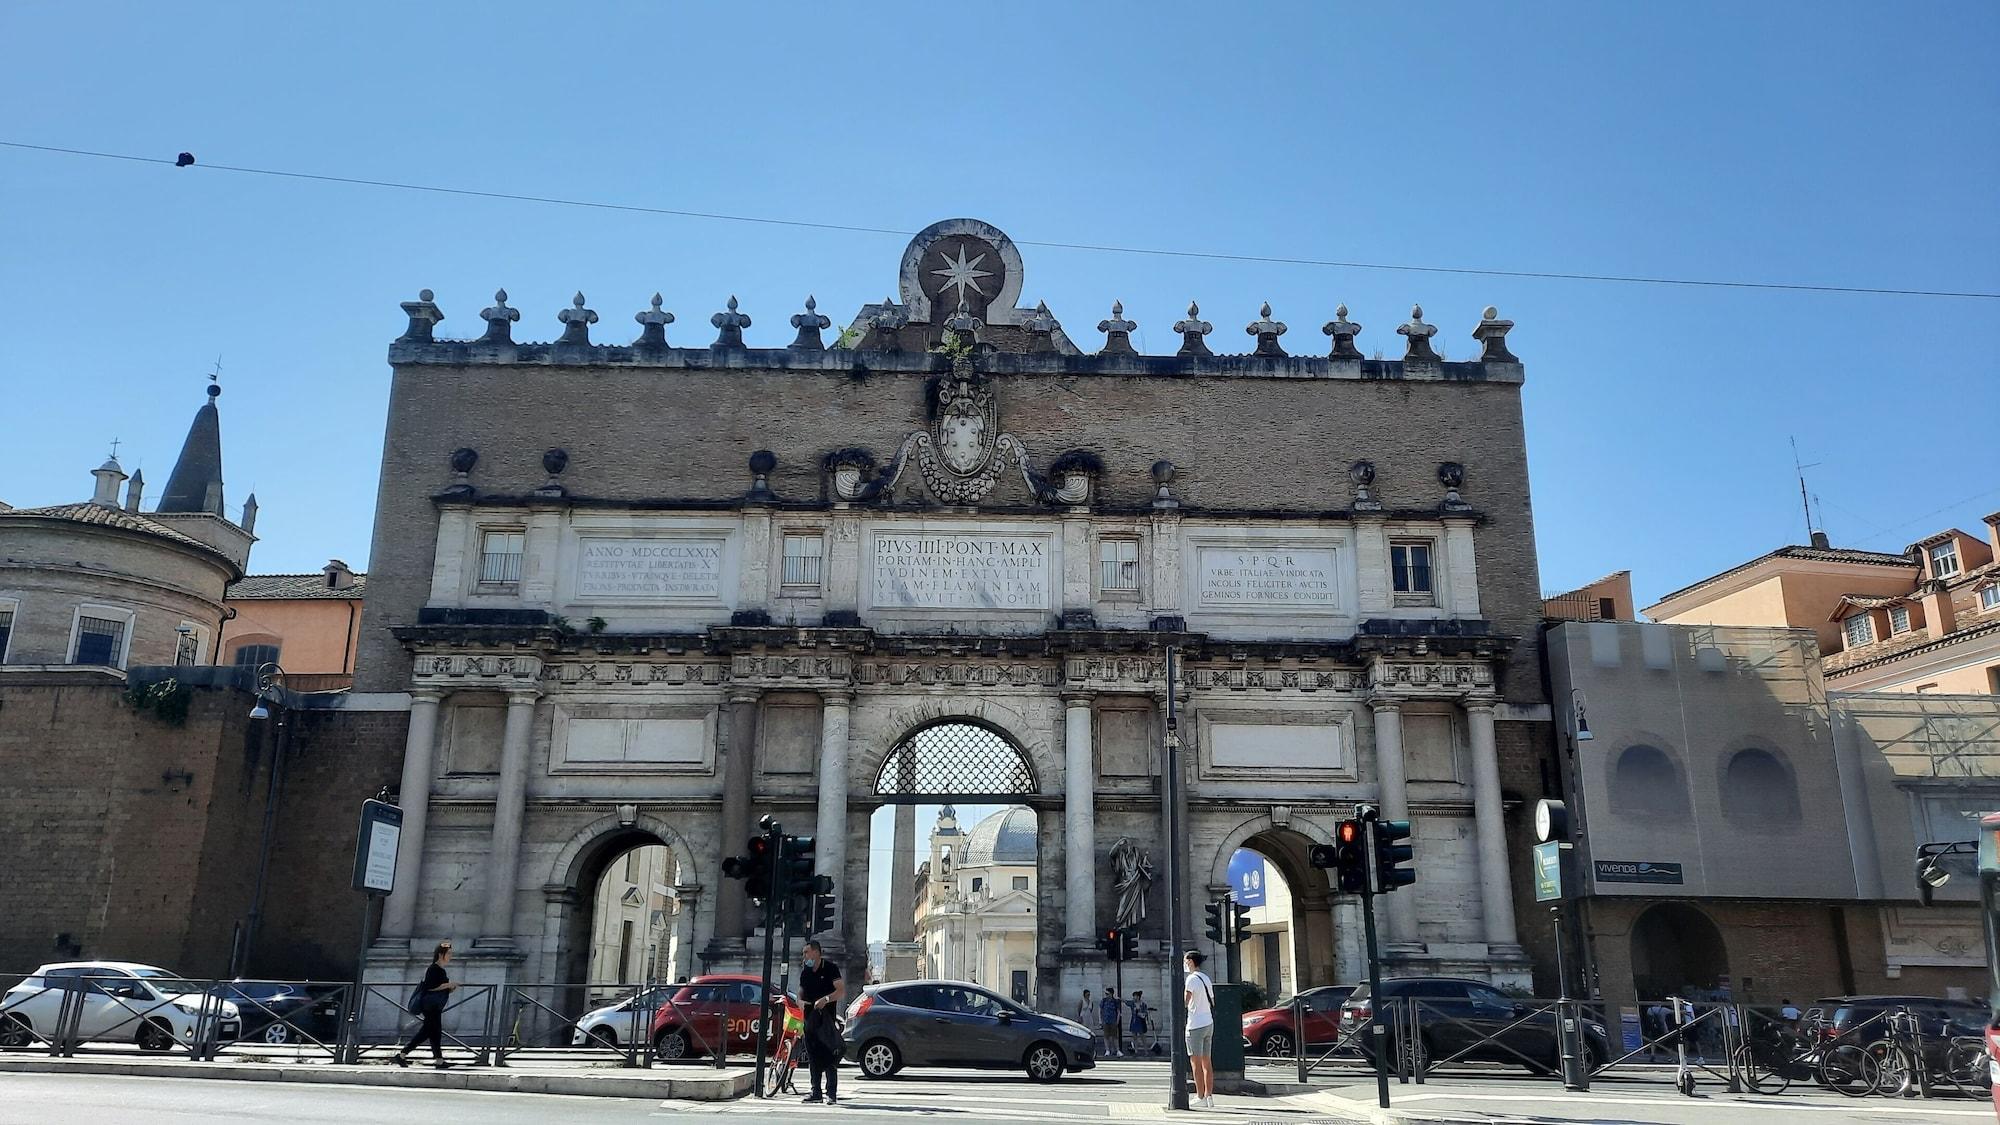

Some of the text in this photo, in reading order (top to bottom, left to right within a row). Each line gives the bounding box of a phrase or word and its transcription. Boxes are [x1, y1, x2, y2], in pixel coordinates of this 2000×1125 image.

[584, 547, 624, 558] ANNO
[877, 539, 912, 554] PIVS
[946, 541, 997, 555] PONT
[1001, 542, 1043, 556] MAX
[877, 555, 1041, 568] PORTAM IN HANC AMPLI
[877, 567, 1033, 579] TVDINEM EXTVLIT
[1211, 569, 1324, 578] VRBE ITALIAE VINDICATA
[877, 579, 1041, 592] VIAM FLAMINIAM
[1208, 580, 1241, 588] INCOLIS
[1247, 580, 1293, 589] FELICITER
[877, 592, 957, 603] STRAVIT
[1202, 591, 1241, 599] GEMINOS
[1246, 591, 1289, 600] FORNICES
